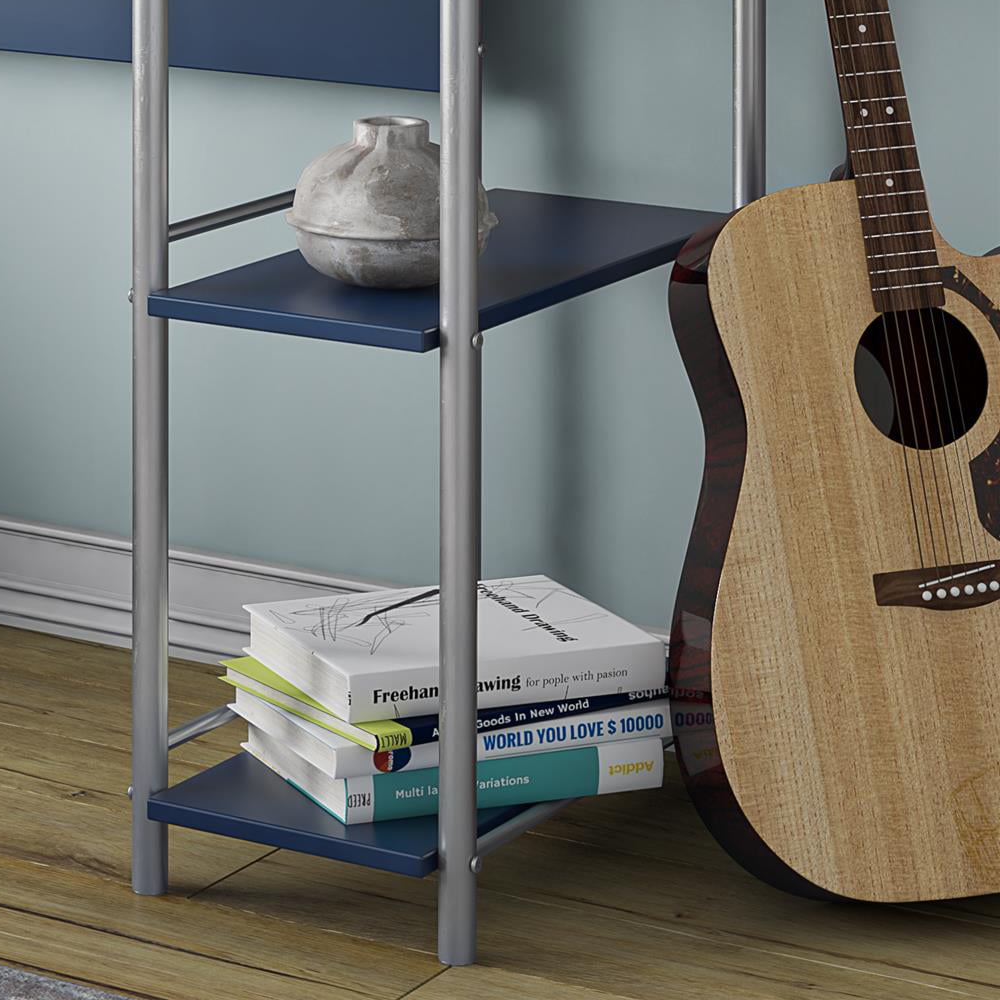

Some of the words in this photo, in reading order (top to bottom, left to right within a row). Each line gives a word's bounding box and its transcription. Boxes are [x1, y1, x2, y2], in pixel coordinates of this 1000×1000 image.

[522, 613, 578, 642] Drawing
[373, 686, 439, 704] Freehan
[477, 675, 521, 692] awing
[526, 677, 538, 687] for
[542, 675, 569, 688] pople
[572, 670, 594, 682] with
[597, 668, 628, 682] pasion
[477, 714, 511, 729] Goods
[515, 711, 526, 721] In
[530, 706, 555, 718] New
[557, 699, 590, 713] World
[381, 732, 407, 748] MALLT
[483, 731, 533, 750] WORLD
[537, 726, 566, 743] YOU
[570, 721, 604, 739] LOVE
[608, 718, 616, 735] $
[622, 714, 664, 732] 10000
[608, 760, 654, 776] Addict
[395, 787, 424, 799] Multi
